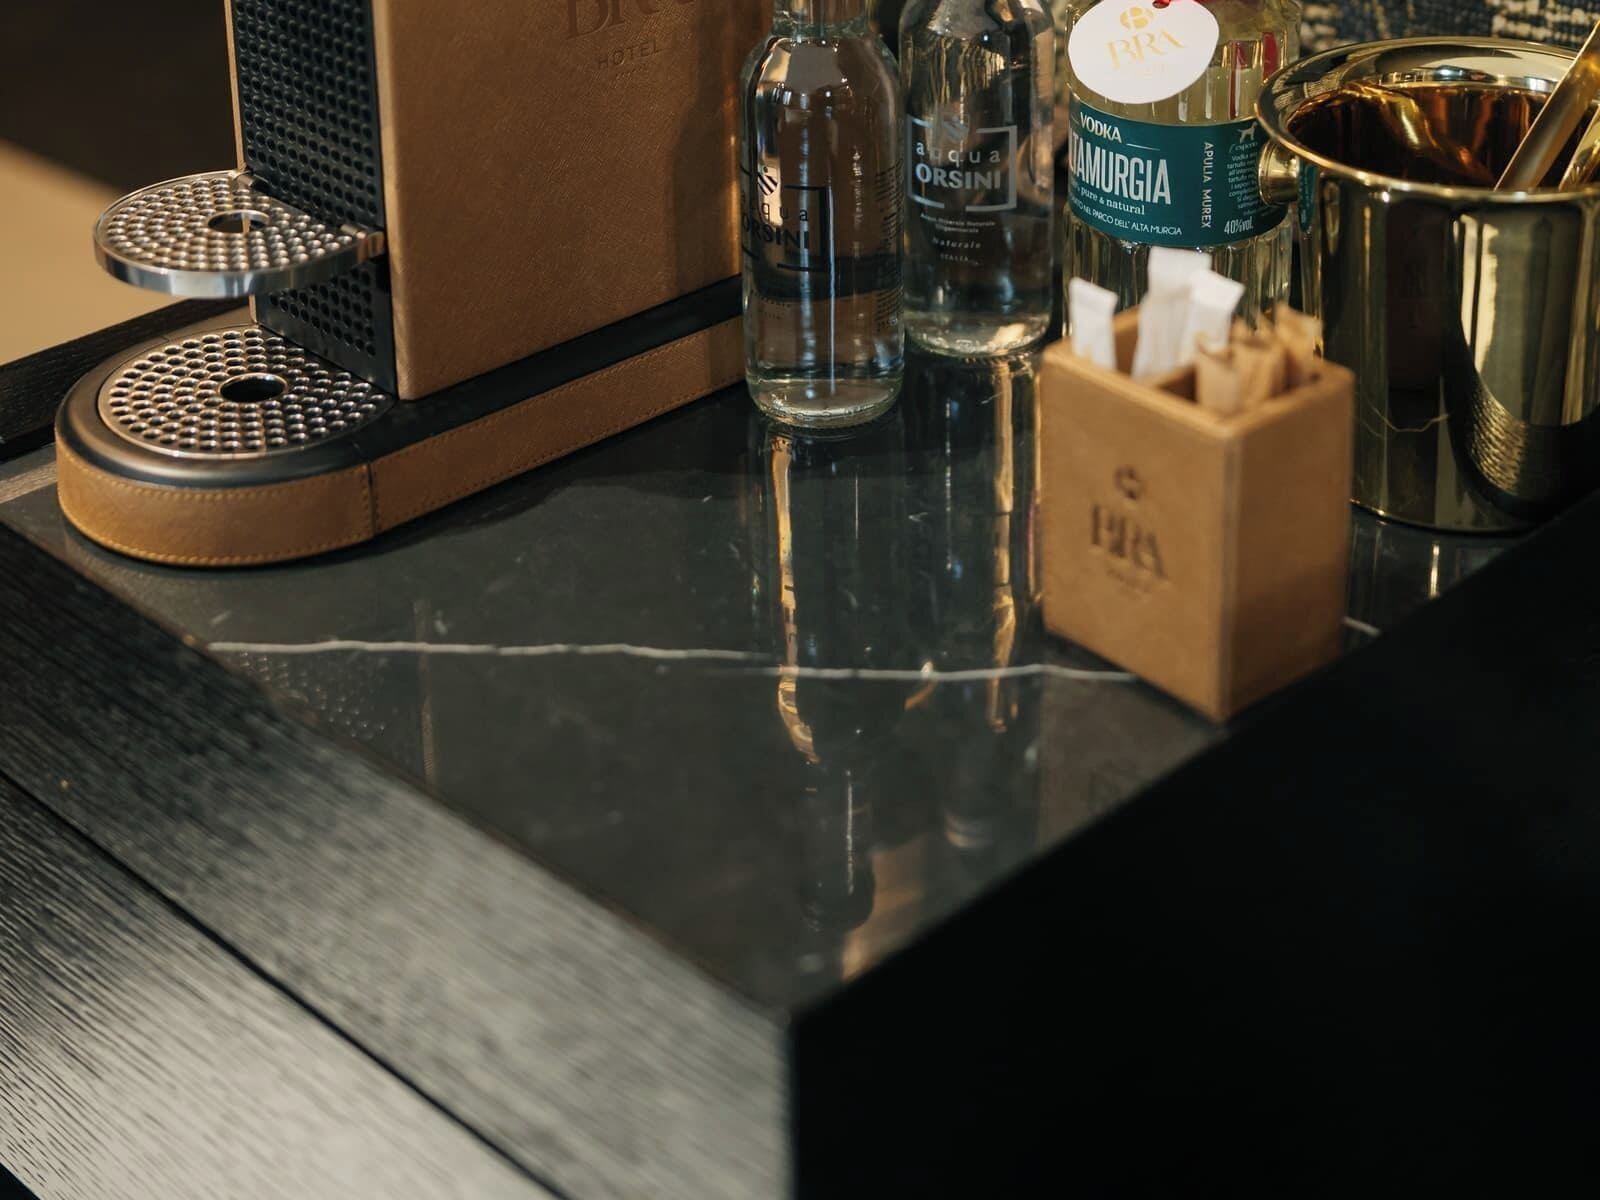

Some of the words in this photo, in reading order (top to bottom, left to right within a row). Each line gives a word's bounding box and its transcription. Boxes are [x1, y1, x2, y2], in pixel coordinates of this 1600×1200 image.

[597, 39, 662, 69] HOTEL
[1105, 29, 1187, 70] BRA
[1080, 111, 1122, 143] VODKA
[916, 163, 1001, 190] ORSINI
[1203, 141, 1214, 183] APULIA
[1080, 186, 1098, 201] pure
[1106, 198, 1145, 215] natural
[1201, 188, 1213, 229] MUREX
[742, 213, 810, 249] ORSINI
[1092, 208, 1114, 224] PARCO
[1131, 221, 1149, 233] ALTA
[1150, 224, 1183, 236] MURGIA
